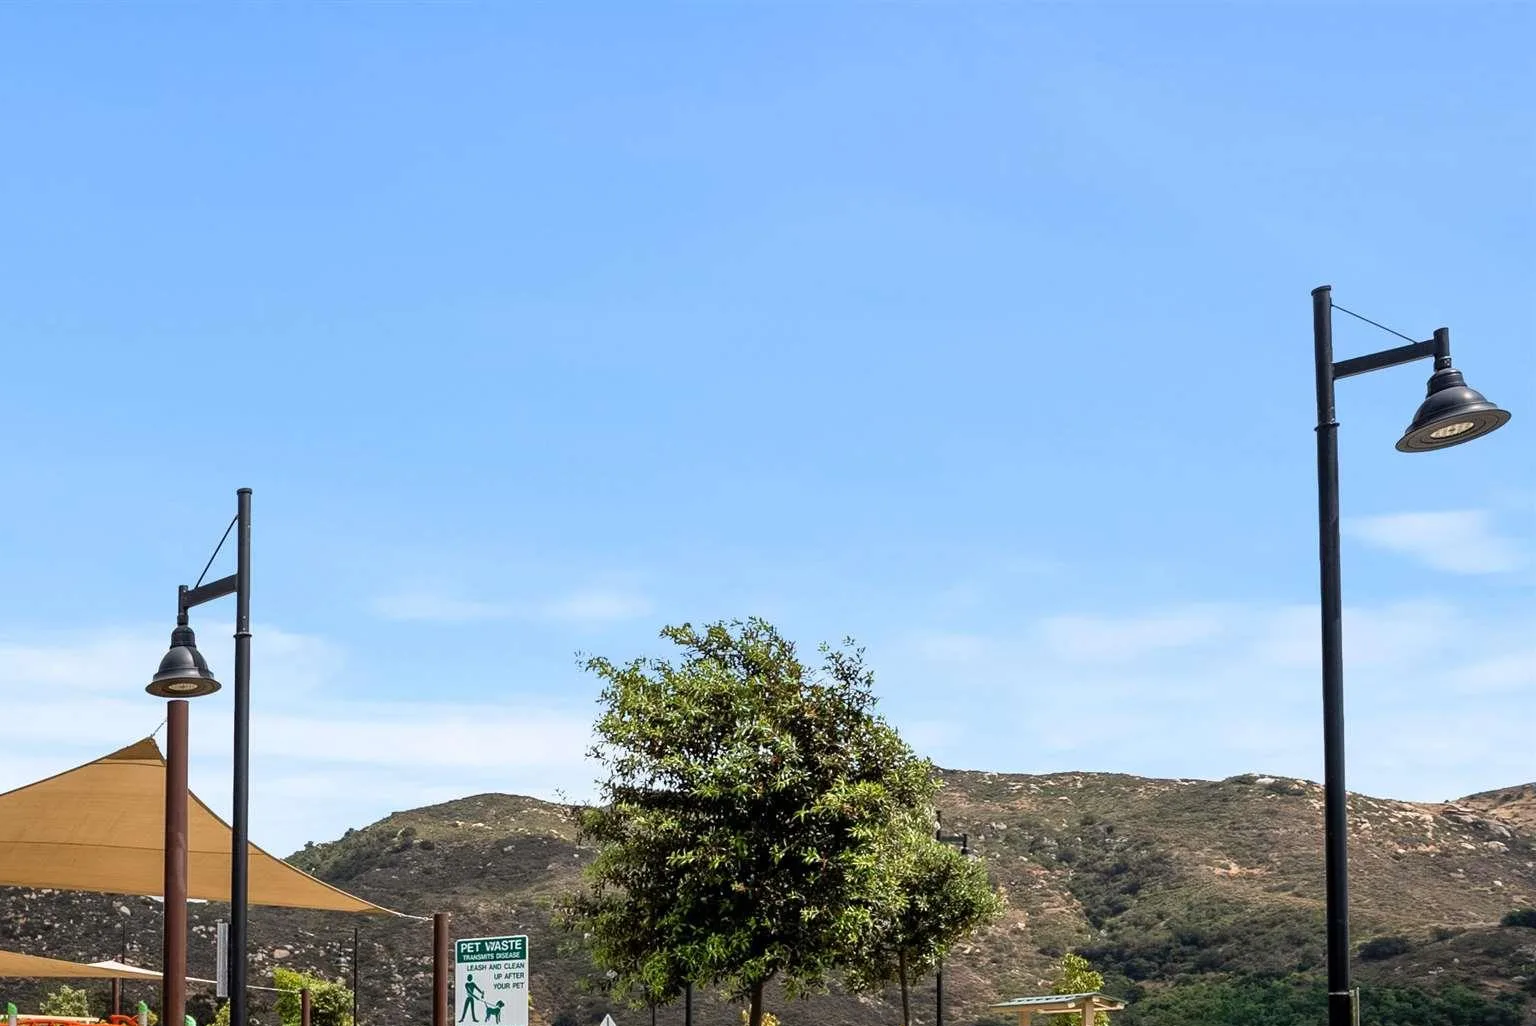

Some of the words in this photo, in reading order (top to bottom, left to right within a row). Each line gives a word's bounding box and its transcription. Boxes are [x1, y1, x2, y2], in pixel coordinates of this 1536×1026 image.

[460, 942, 481, 953] PET
[484, 939, 522, 951] WASTE
[462, 953, 495, 961] TRANSMITS
[495, 951, 520, 959] DISEASE
